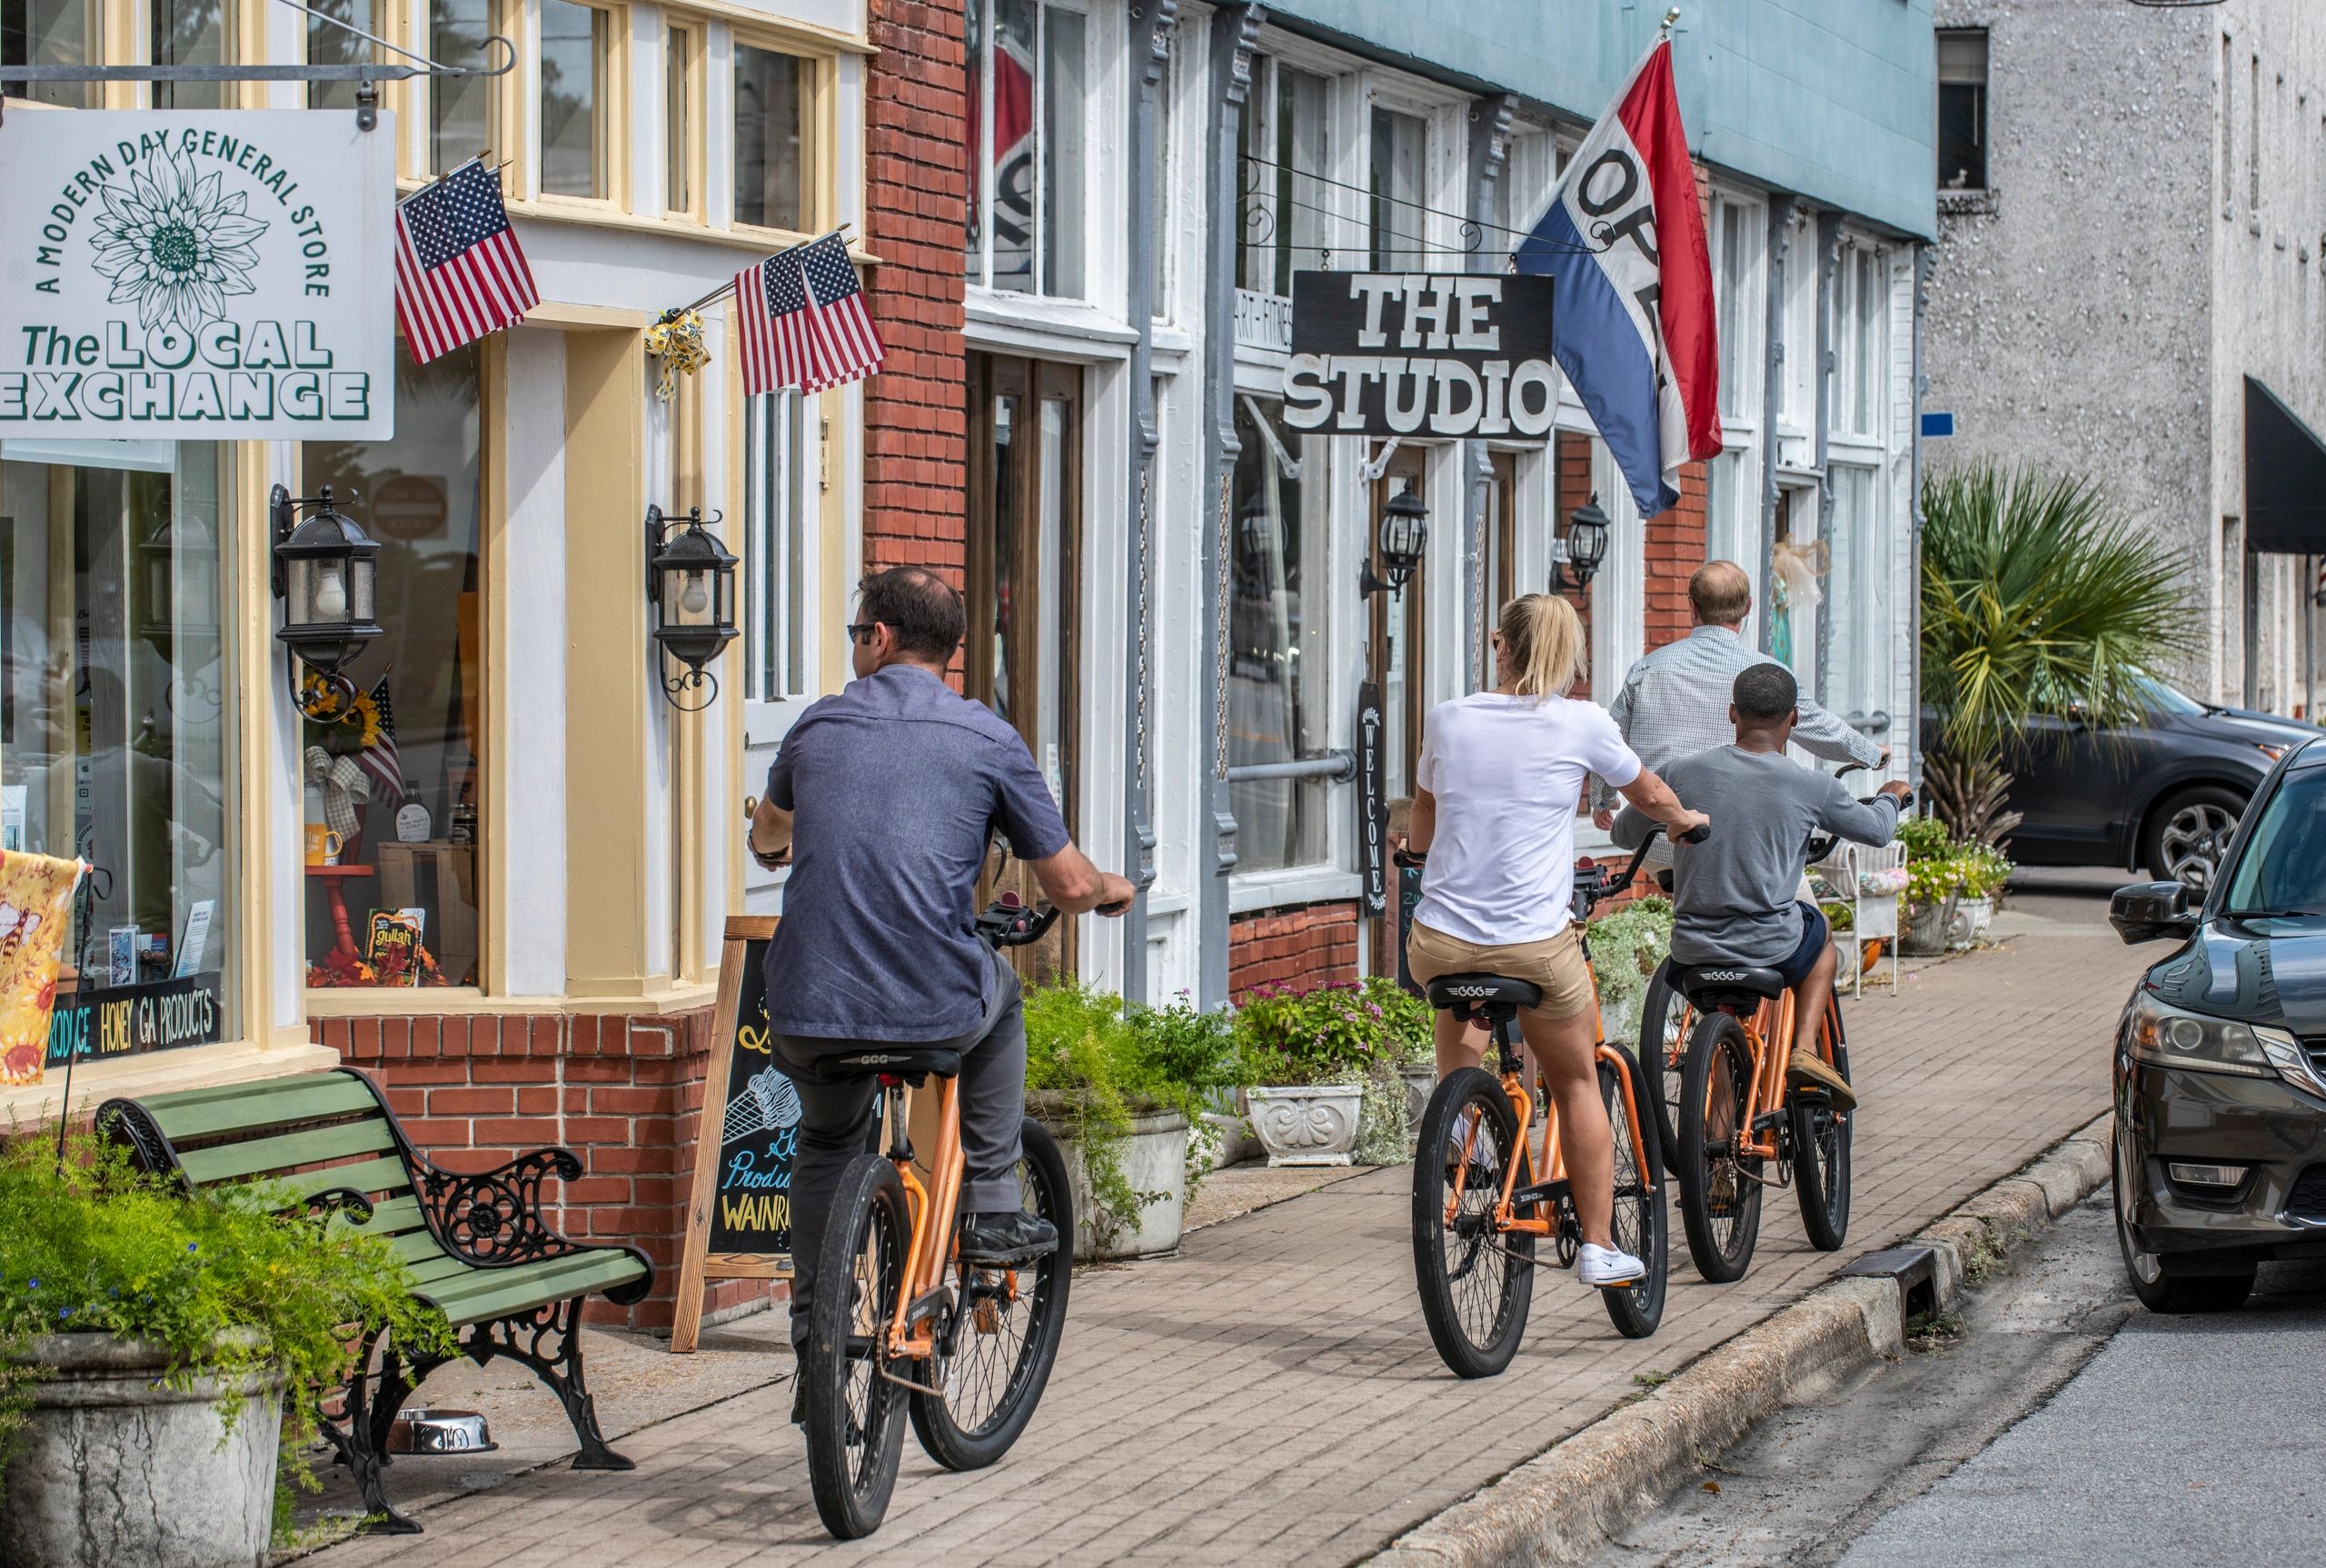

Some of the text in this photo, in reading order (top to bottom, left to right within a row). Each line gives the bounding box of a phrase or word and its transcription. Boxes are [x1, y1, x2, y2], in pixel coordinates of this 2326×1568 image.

[35, 127, 330, 298] A MODERN DAY GENERAL STORE
[1349, 273, 1502, 351] THE
[21, 320, 334, 370] The LOCAL
[0, 372, 370, 422] EXCHANGE
[1282, 352, 1560, 436] STUDIO
[1365, 724, 1382, 893] WELCOME
[375, 928, 412, 946] gullah
[49, 987, 213, 1059] RODUCE HONEY GA PRODUCTS
[721, 1150, 792, 1190] Produ
[721, 1193, 791, 1232] WAINRI
